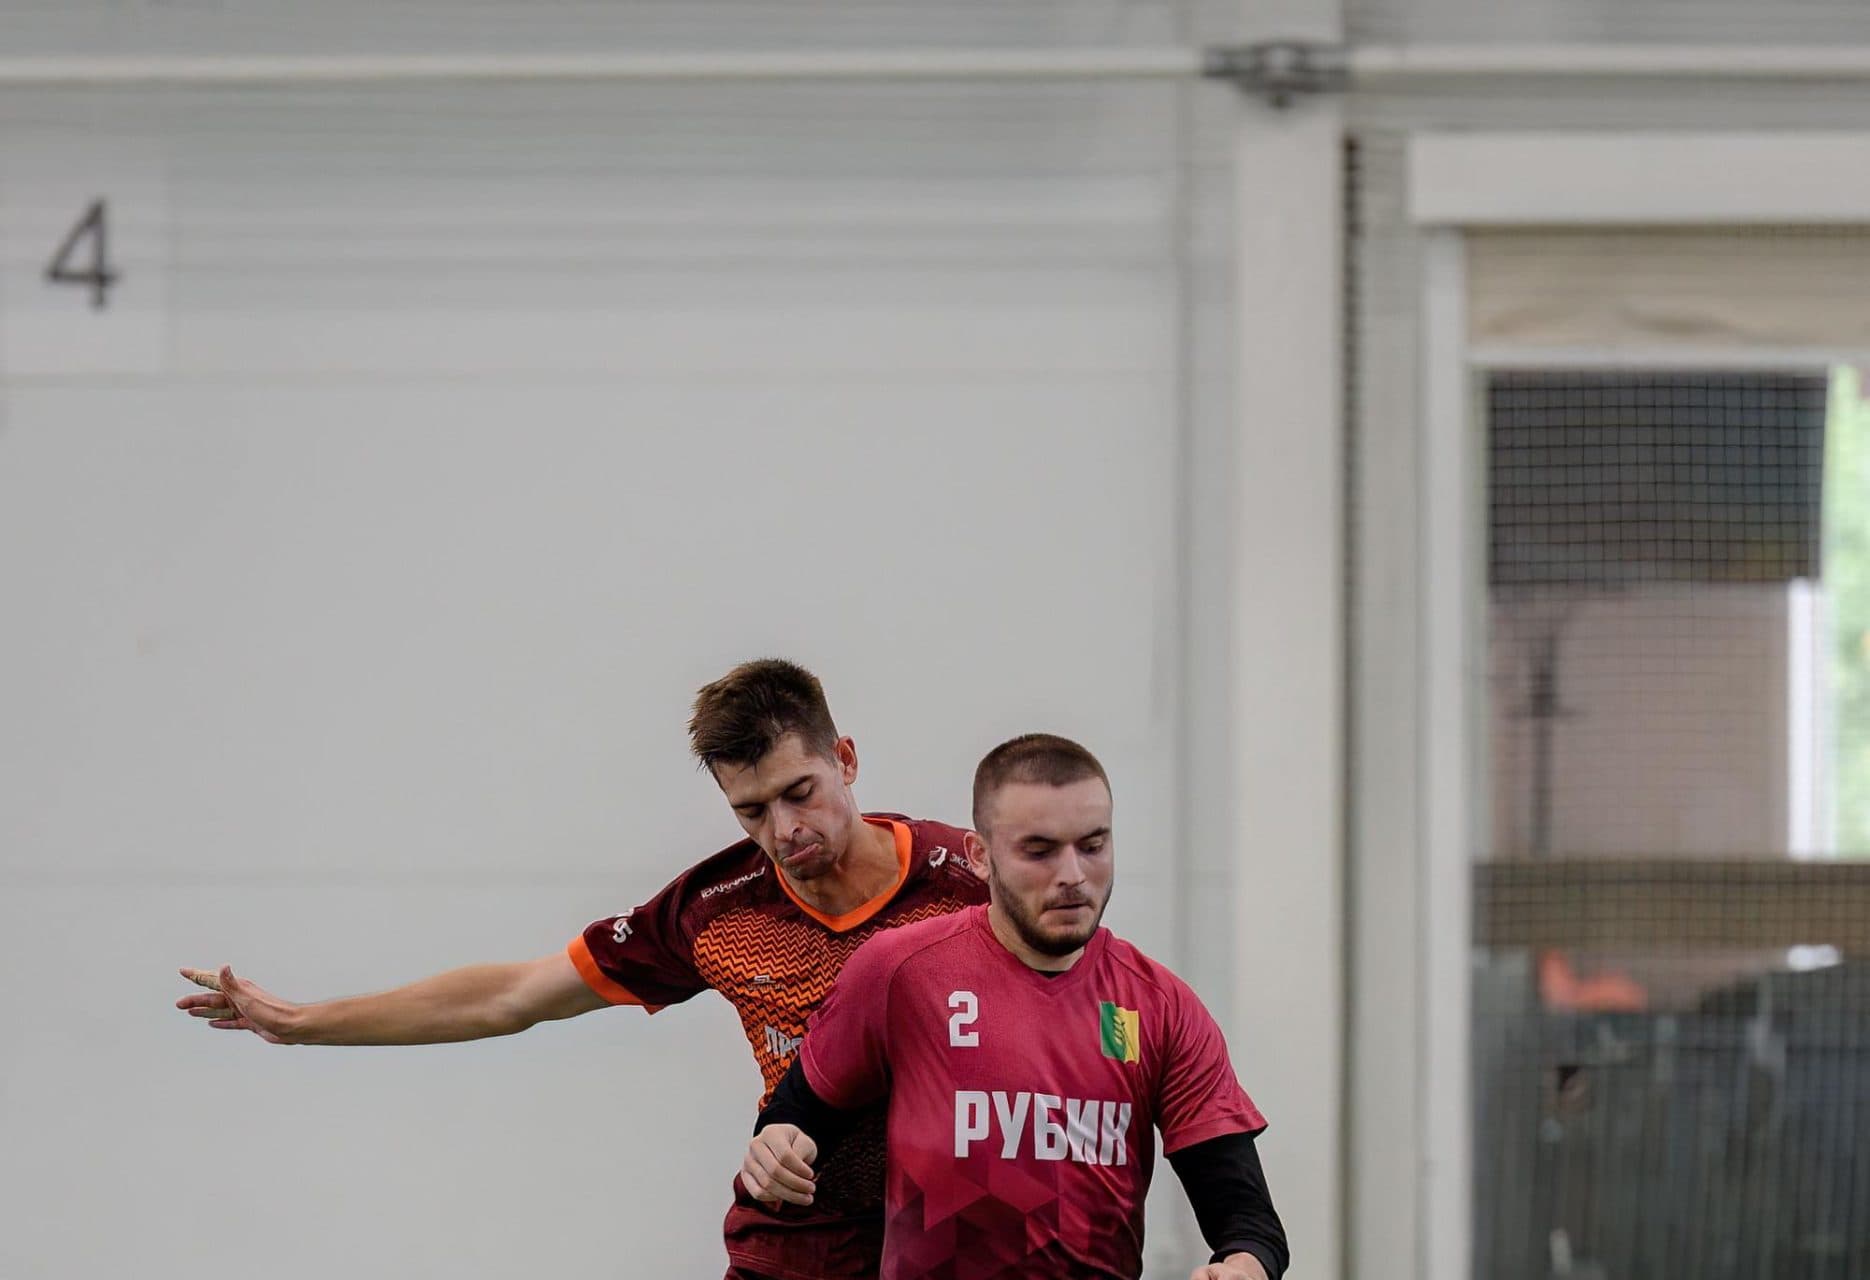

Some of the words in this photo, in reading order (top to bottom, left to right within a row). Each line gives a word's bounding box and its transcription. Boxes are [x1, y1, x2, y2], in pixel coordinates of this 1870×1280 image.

[44, 198, 123, 310] 4
[948, 991, 979, 1047] 2
[954, 1090, 1132, 1166] РУБИН
